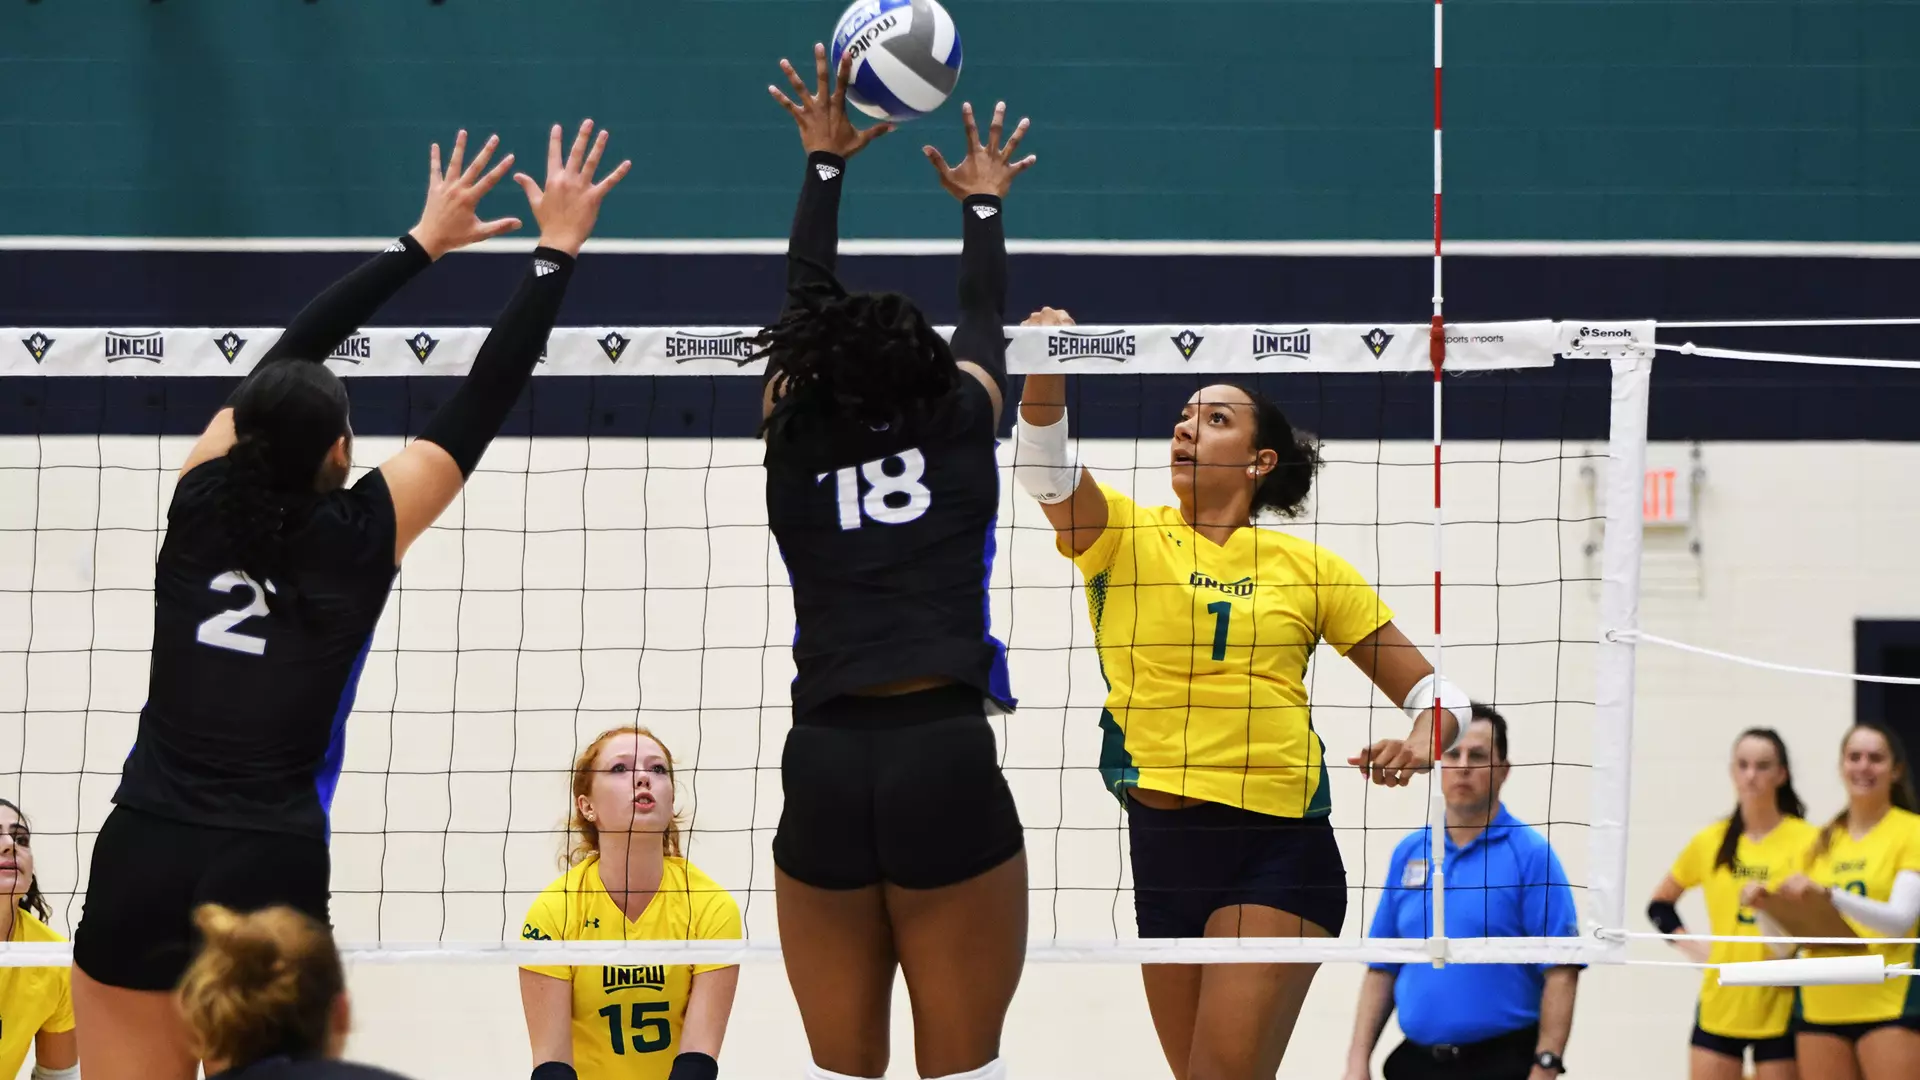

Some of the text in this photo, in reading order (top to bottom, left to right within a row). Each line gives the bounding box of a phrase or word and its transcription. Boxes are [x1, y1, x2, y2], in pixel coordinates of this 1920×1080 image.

[849, 15, 897, 59] molte
[1253, 333, 1311, 355] UNCW
[1591, 328, 1632, 338] Senoh
[105, 336, 164, 358] UNCW
[666, 336, 753, 358] SEAHAWKS
[1048, 335, 1136, 357] SEAHAWKS
[816, 447, 932, 532] 18
[1189, 571, 1254, 597] UNCW
[197, 569, 277, 656] 2
[1207, 600, 1232, 662] 1
[602, 964, 666, 988] UNCW
[598, 1001, 672, 1055] 15
